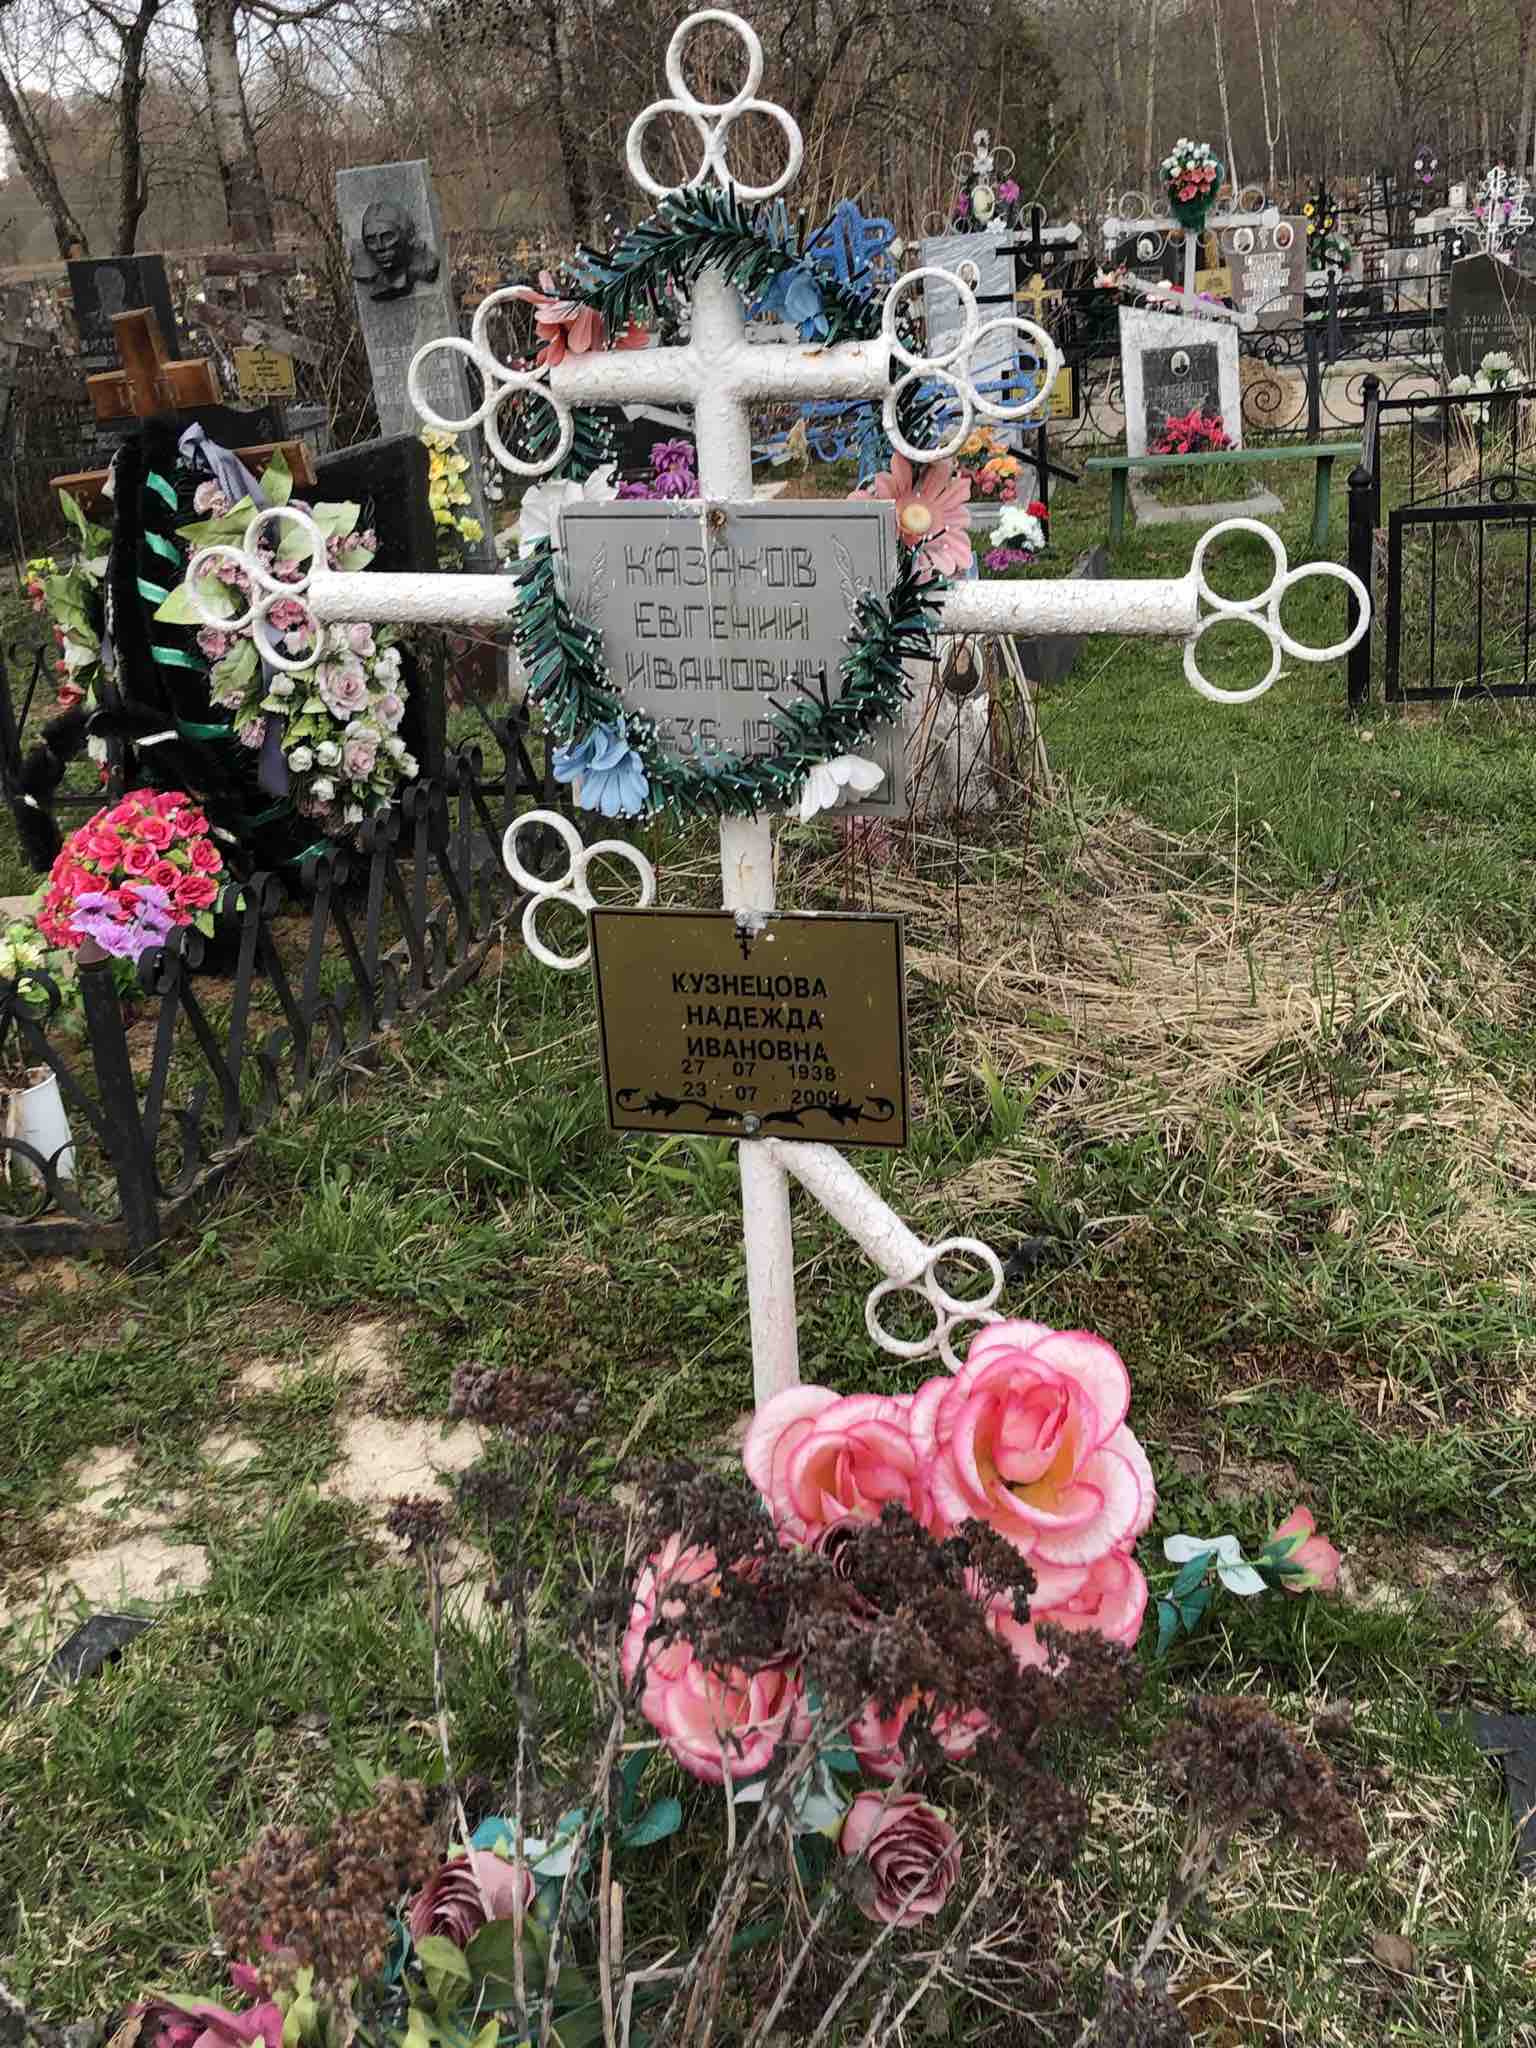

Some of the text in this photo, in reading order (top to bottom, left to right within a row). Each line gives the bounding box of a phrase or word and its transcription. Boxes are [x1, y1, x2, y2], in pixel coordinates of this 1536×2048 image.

[624, 545, 816, 587] КАЗАКОВ
[634, 599, 809, 640] ЕВГЕНИЙ
[625, 651, 828, 692] ИВАНОВИЧ
[672, 972, 828, 1000] КУЗНЕЦОВА
[687, 1005, 823, 1032] НАДЕЖДА
[687, 1036, 828, 1062] ИВАНОВНА
[788, 1064, 836, 1082] 1938
